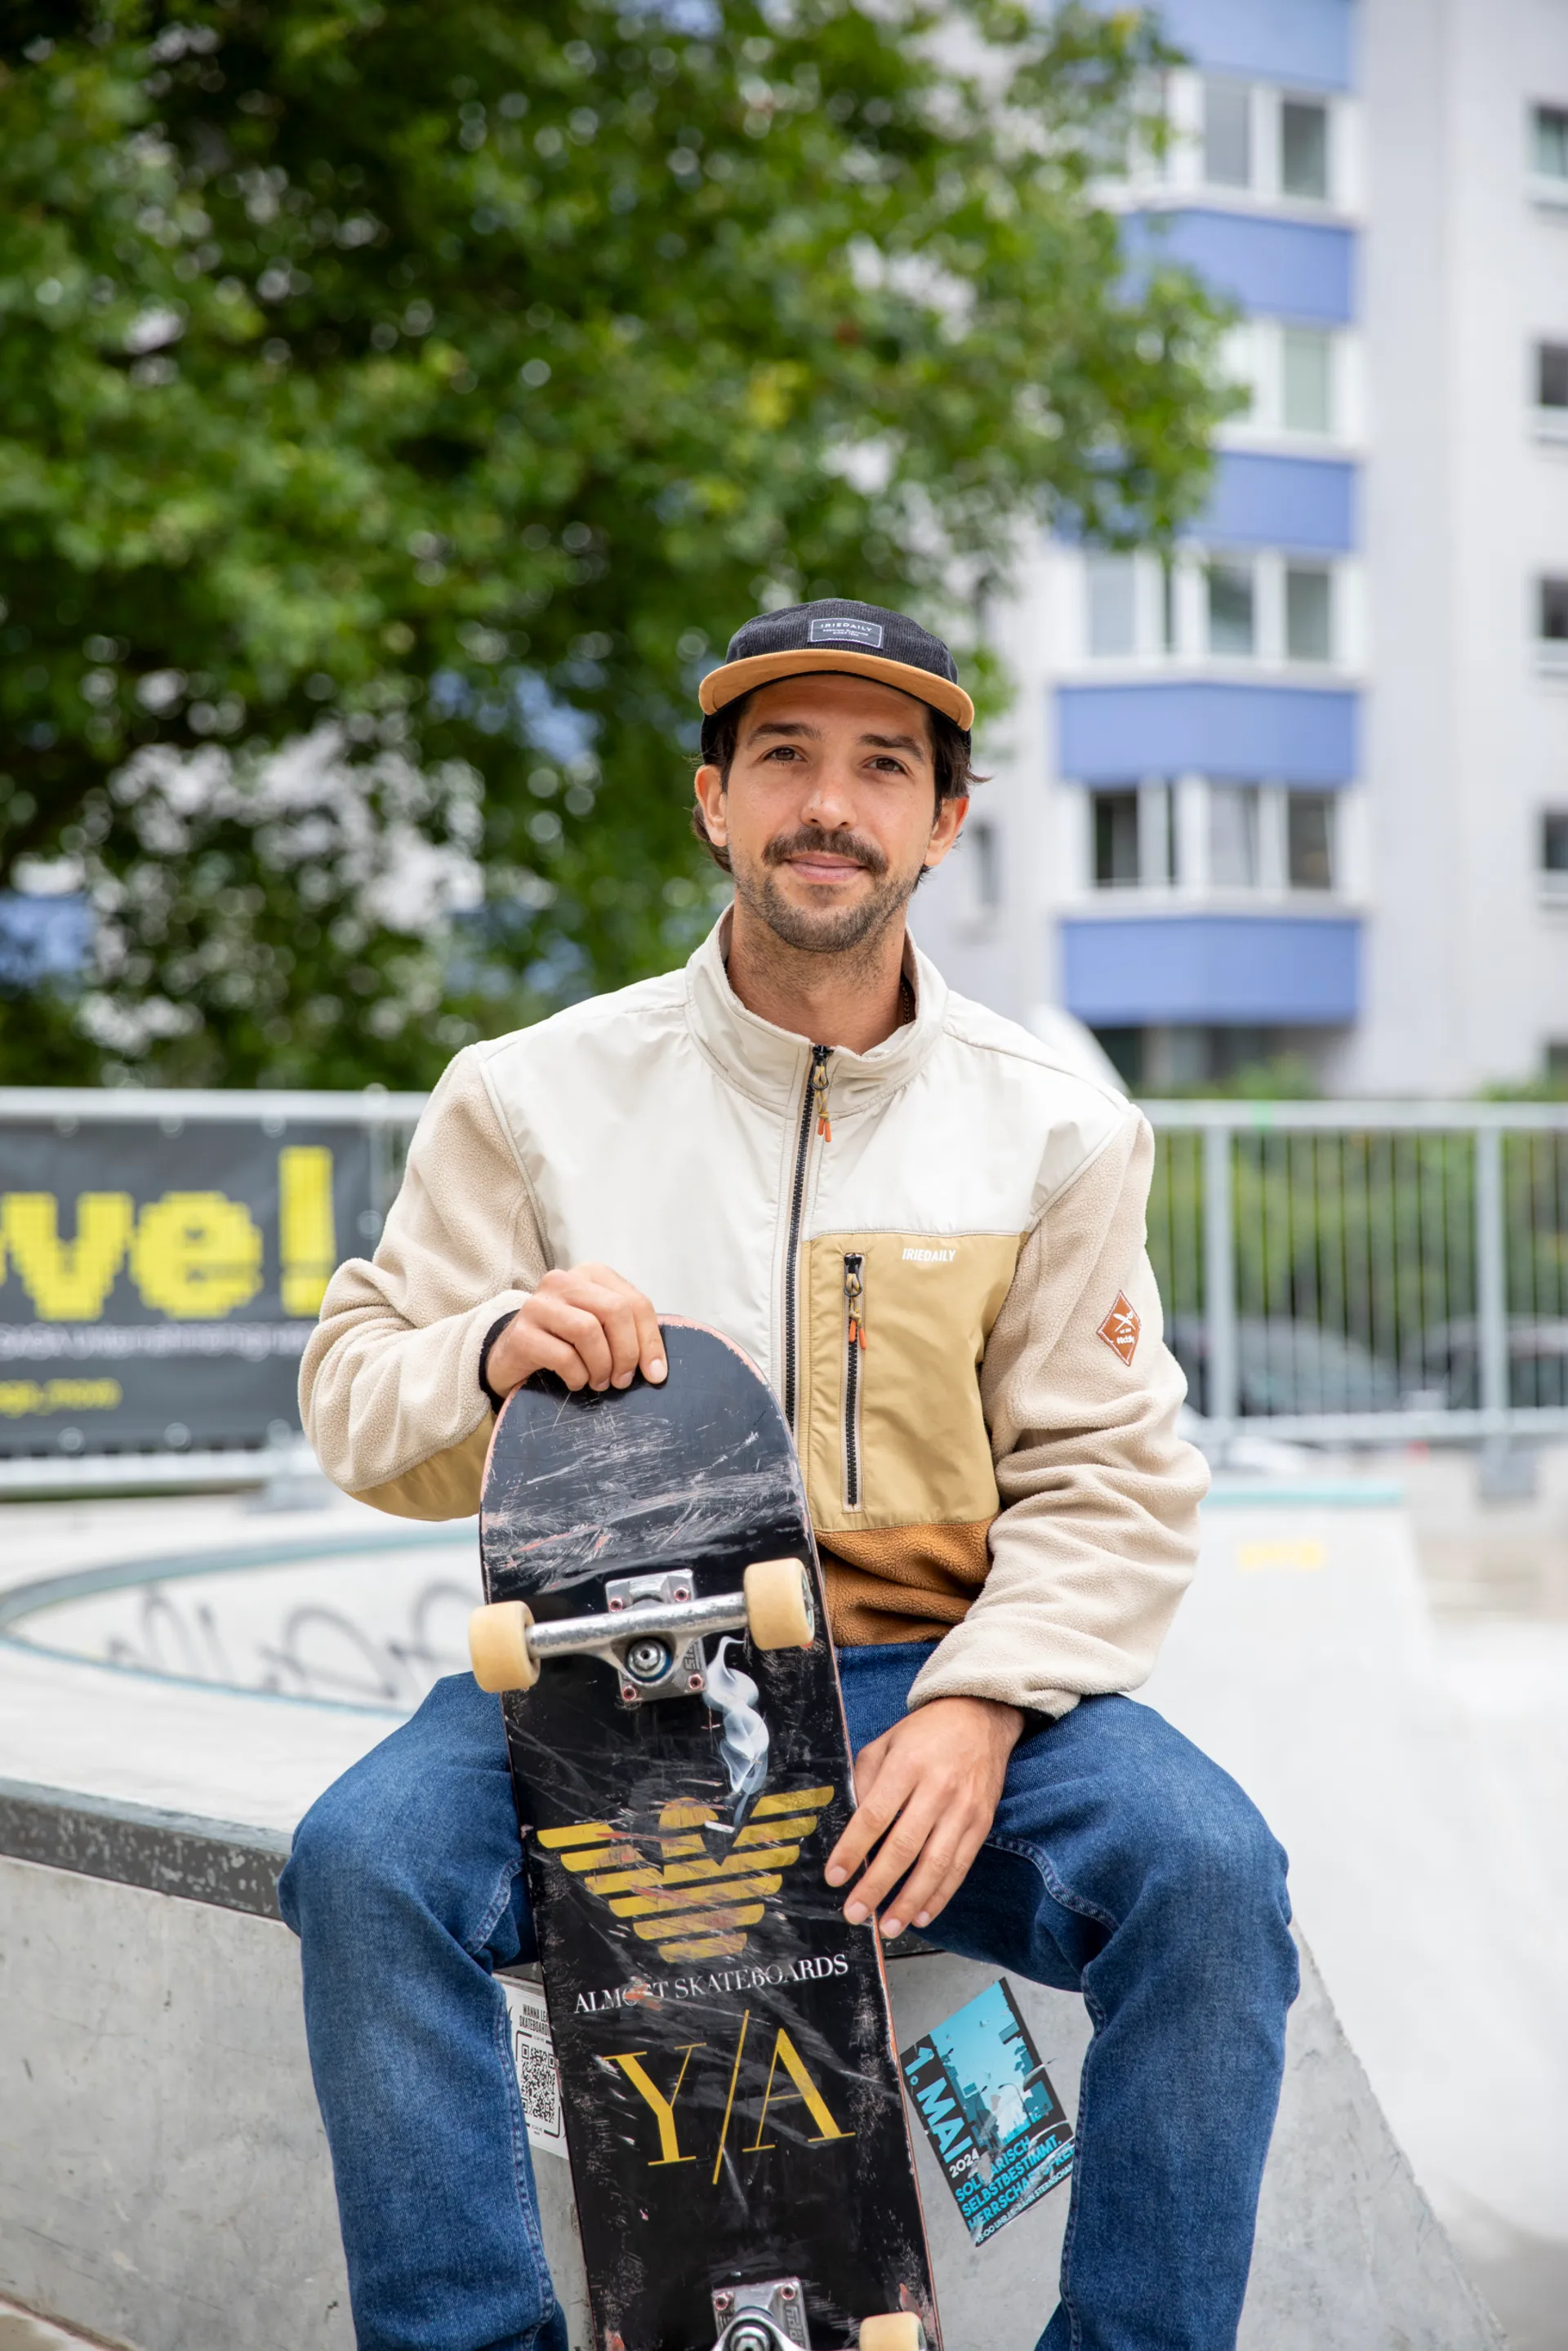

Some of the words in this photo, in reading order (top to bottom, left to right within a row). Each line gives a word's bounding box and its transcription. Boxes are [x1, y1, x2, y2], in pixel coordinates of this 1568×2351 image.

[821, 622, 872, 632] IRIEDAILY
[0, 1147, 335, 1321] ve!
[902, 1248, 956, 1262] IRIEDAILY
[675, 1953, 849, 2000] SKATEBOARDS
[915, 2077, 973, 2164] MAI
[949, 2148, 980, 2179] 2024
[955, 2135, 1031, 2203] SOLIARISCH
